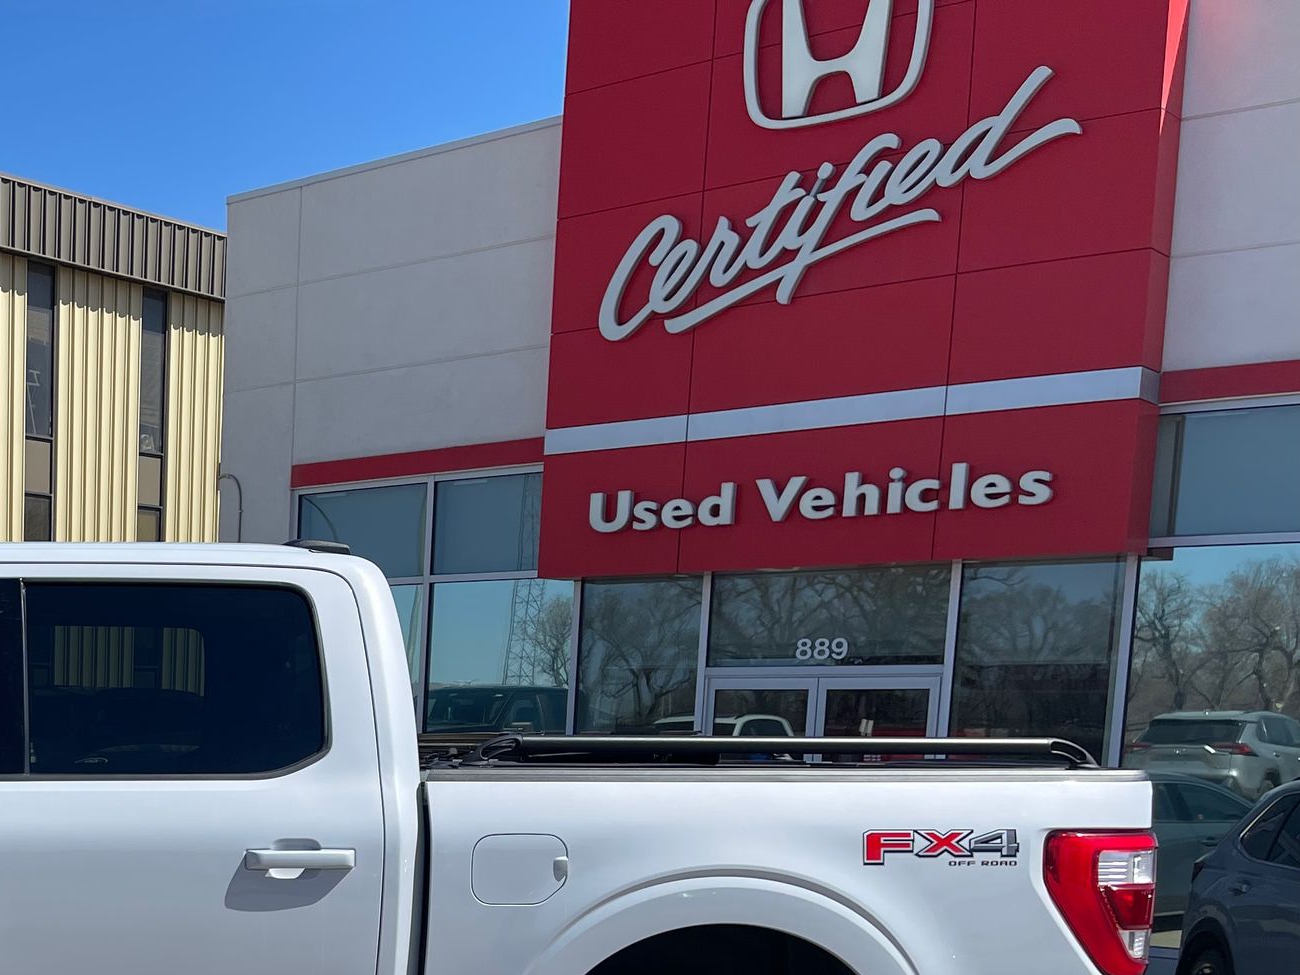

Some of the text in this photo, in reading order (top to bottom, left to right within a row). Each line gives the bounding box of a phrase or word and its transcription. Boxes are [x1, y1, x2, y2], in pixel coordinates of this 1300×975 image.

[598, 65, 1084, 342] Certified
[589, 462, 1054, 533] Used Vehicles
[795, 637, 849, 660] 889
[863, 829, 1019, 866] FX4
